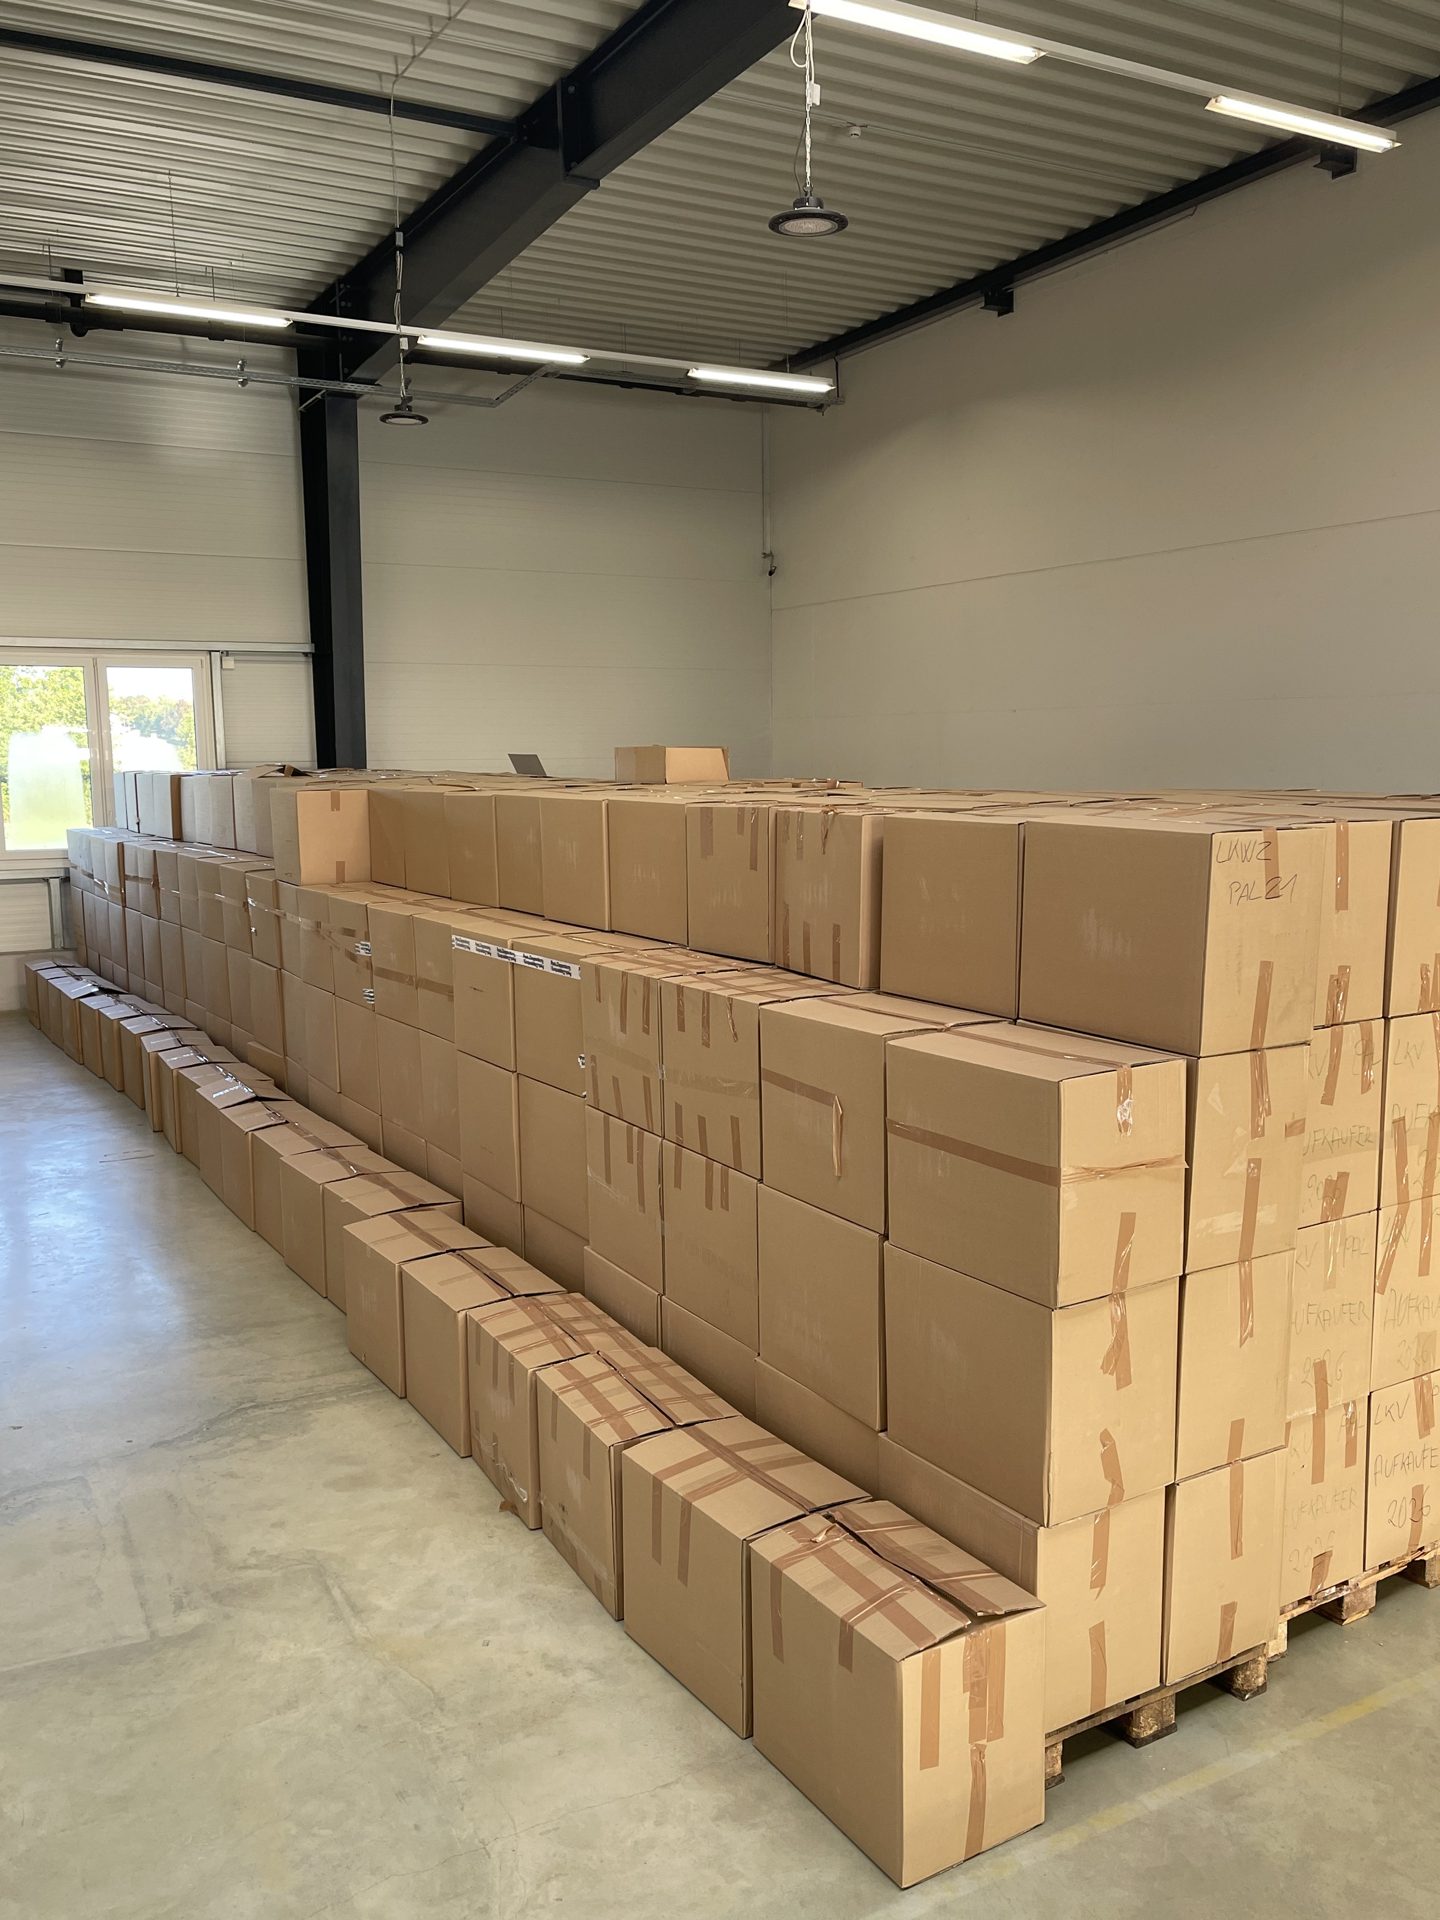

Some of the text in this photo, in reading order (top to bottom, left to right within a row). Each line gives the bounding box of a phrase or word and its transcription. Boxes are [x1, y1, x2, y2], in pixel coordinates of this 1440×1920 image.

[1229, 873, 1298, 907] PAL 21
[1292, 1300, 1370, 1336] UFKAUFER
[1374, 1393, 1410, 1426] LKV
[1387, 1486, 1431, 1528] 2026
